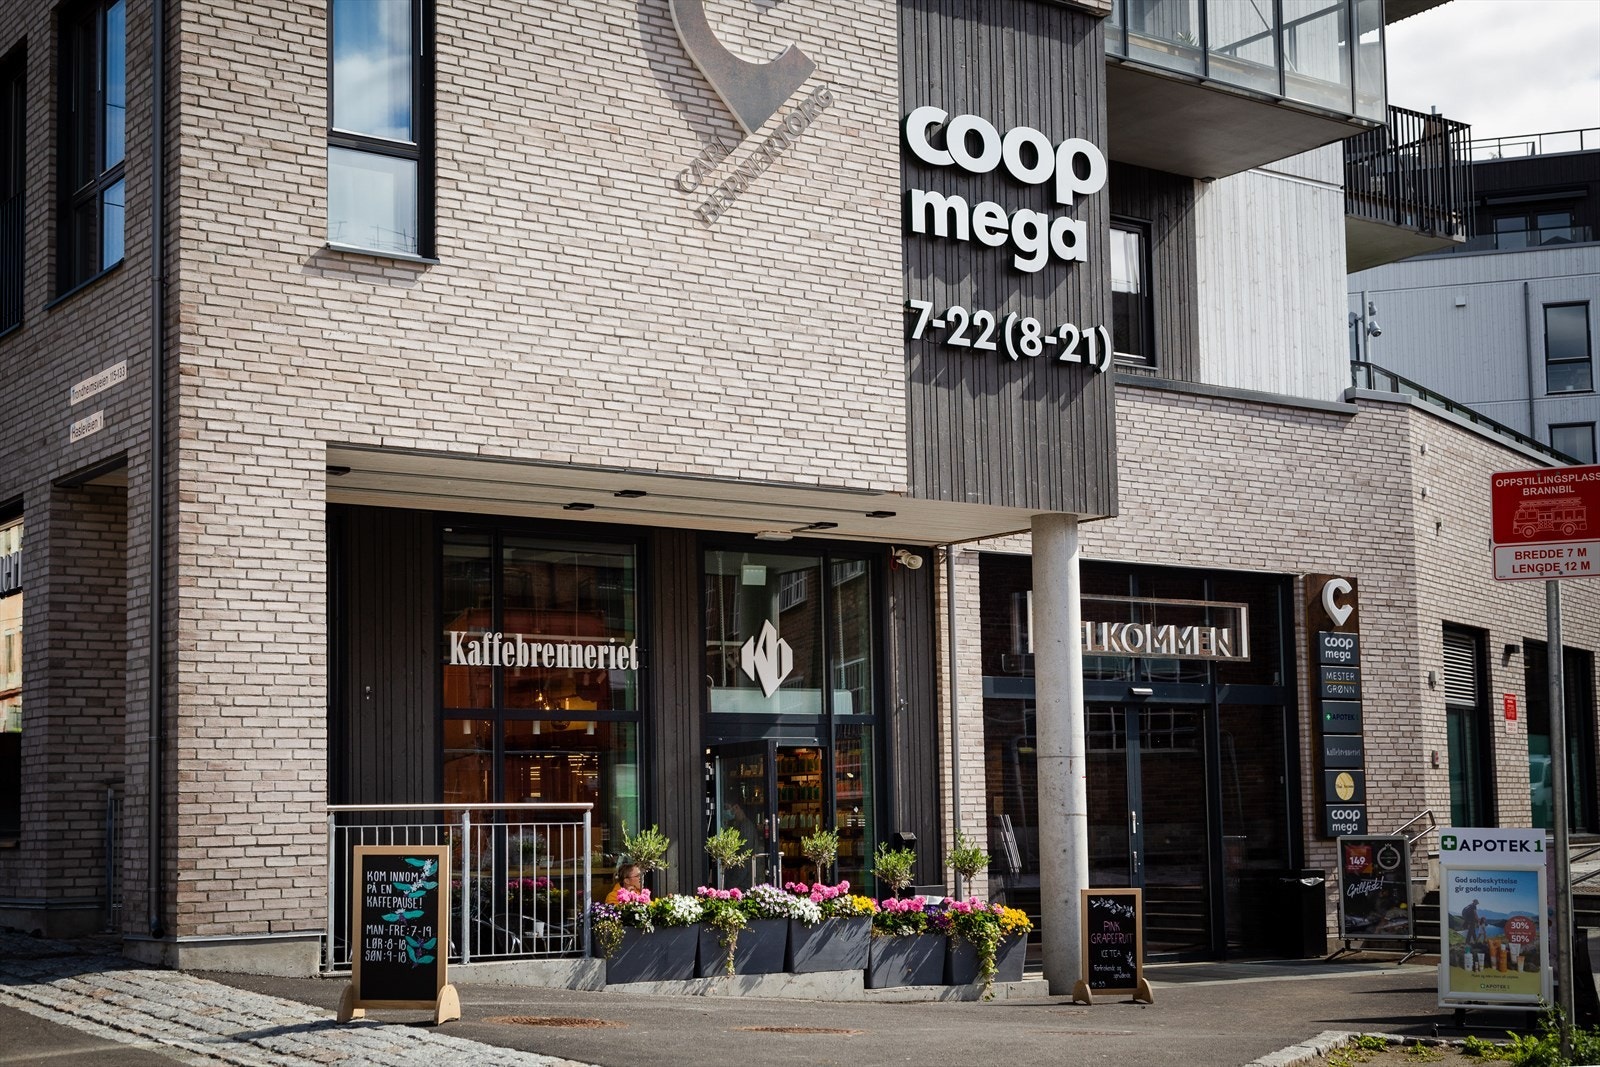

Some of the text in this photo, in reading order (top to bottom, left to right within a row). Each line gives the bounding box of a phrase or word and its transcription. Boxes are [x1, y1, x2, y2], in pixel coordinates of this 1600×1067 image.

[906, 105, 1107, 206] coop
[677, 135, 738, 194] CARL
[910, 188, 1088, 273] mega
[907, 299, 1111, 373] 7-22 (8-21)
[72, 375, 108, 401] Trondheimsveien
[71, 419, 98, 440] Hasleveien
[1495, 472, 1600, 488] OPPSTILLINGSPLASS
[1522, 484, 1575, 496] BRANNBIL
[1514, 547, 1587, 561] BREDDE 7 M
[1512, 560, 1591, 574] LENGDE 12 M
[1324, 636, 1354, 650] coop
[448, 630, 639, 671] Kaffebrenneriet
[1325, 649, 1351, 662] mega
[1326, 671, 1355, 681] MESTER
[1326, 684, 1355, 694] GRØNN
[1332, 713, 1355, 721] APOTEK
[1331, 809, 1361, 822] coop
[1332, 822, 1358, 835] mega
[1458, 839, 1544, 853] APOTEK 1
[1349, 856, 1366, 866] 149
[366, 870, 419, 882] KOM INNOM
[1454, 876, 1518, 886] God solbeskyttelse
[366, 882, 392, 895] PÅ EN
[1454, 885, 1516, 894] gir gode solminner
[1103, 920, 1121, 932] PINK
[1510, 921, 1530, 930] 30%
[1090, 932, 1134, 945] GRAPEFRUIT
[1511, 934, 1530, 944] 50%
[1100, 949, 1122, 958] ICE TEA
